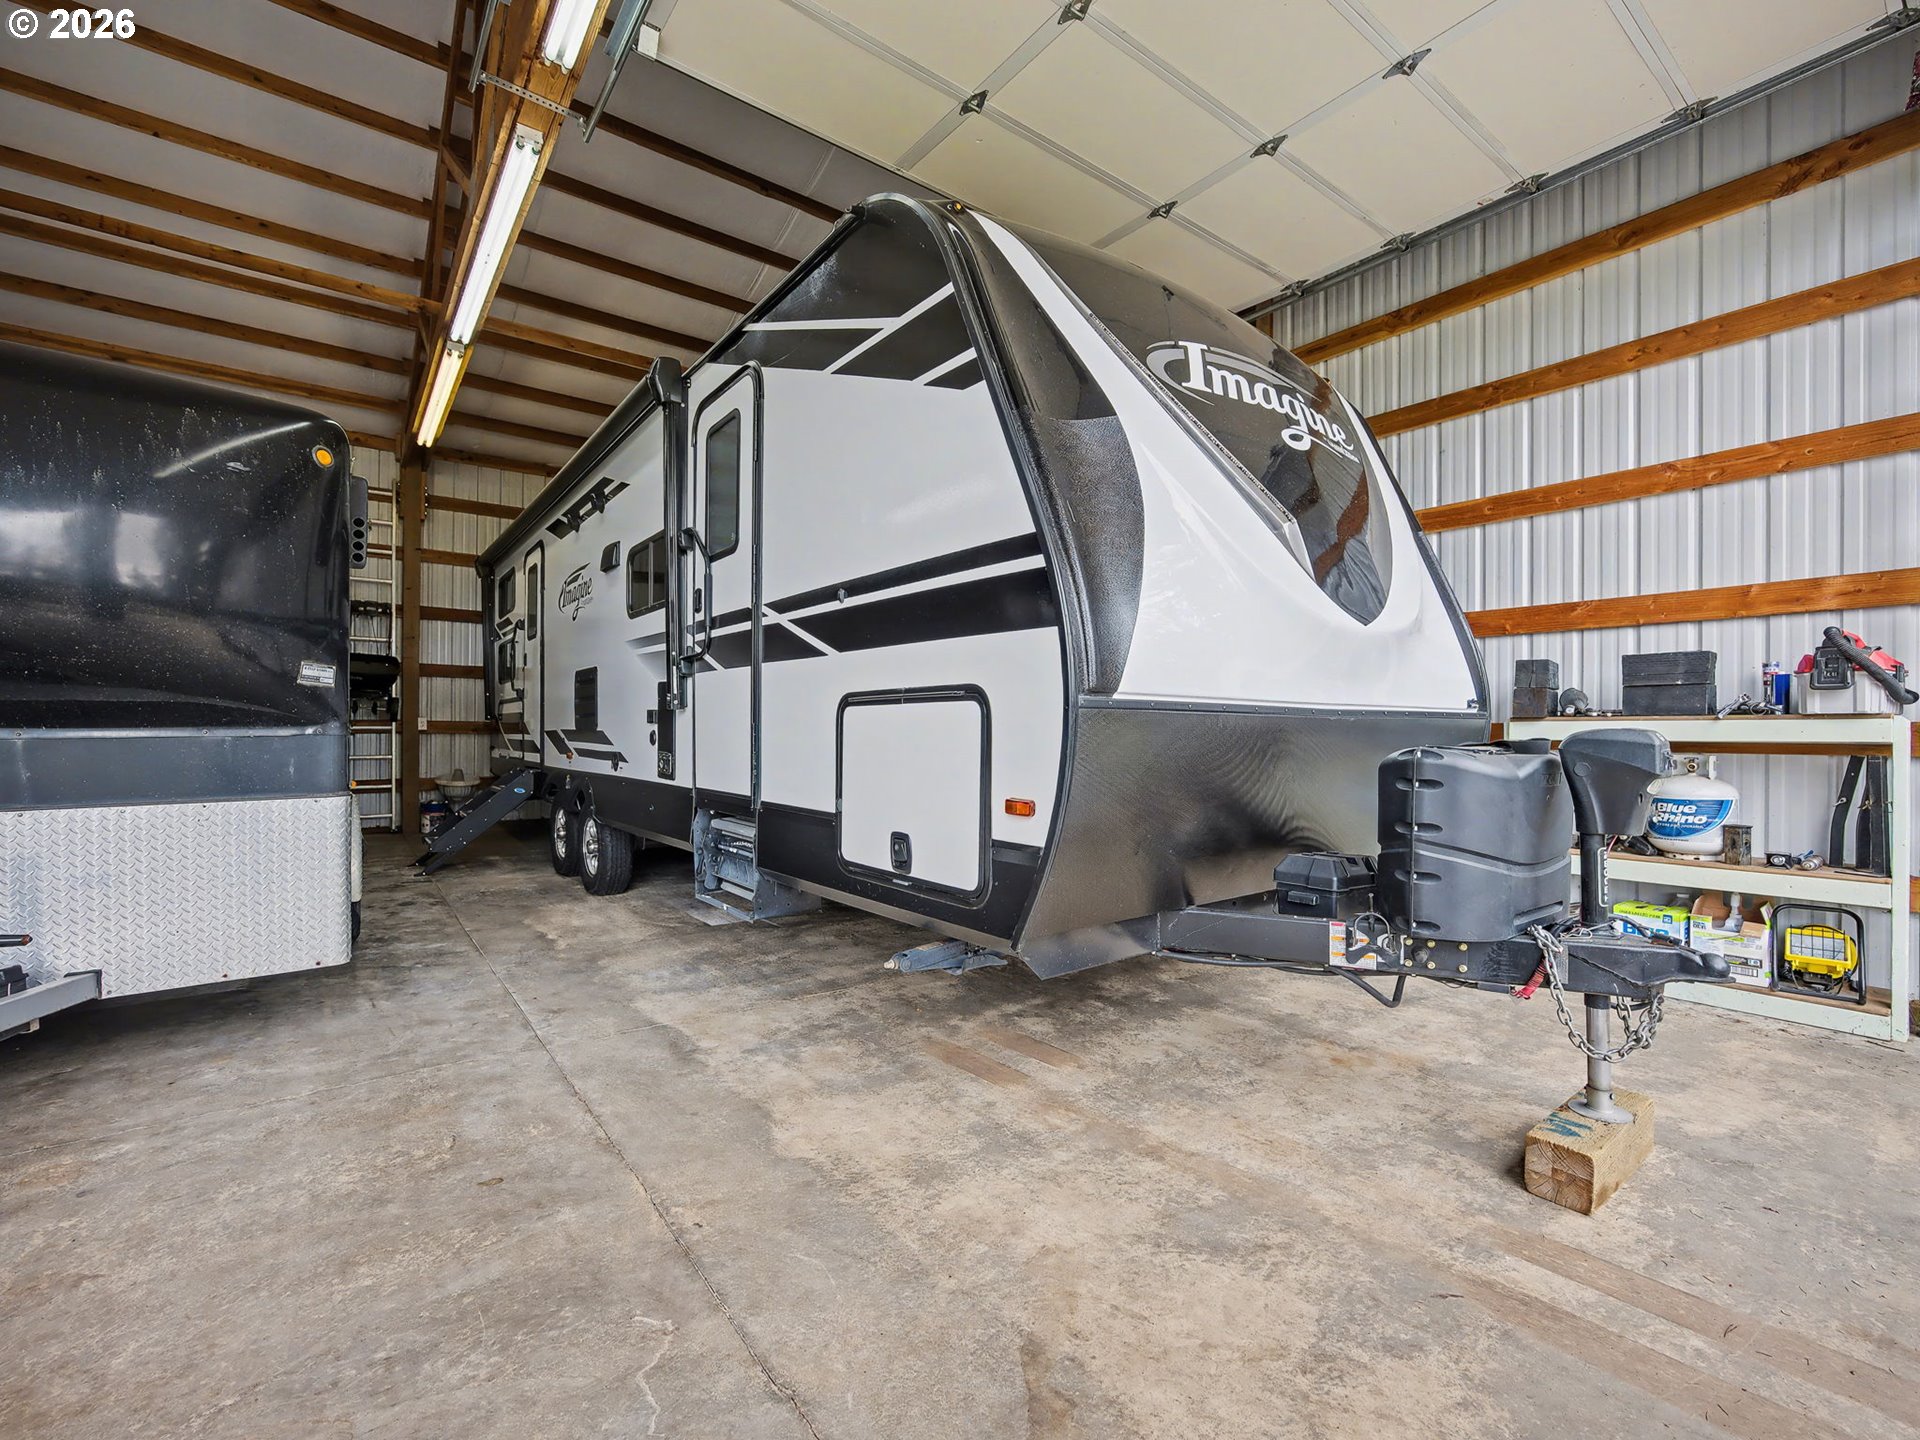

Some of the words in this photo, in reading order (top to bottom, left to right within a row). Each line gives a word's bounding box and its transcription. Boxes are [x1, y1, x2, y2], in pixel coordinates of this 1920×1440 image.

[1177, 340, 1355, 456] Imagine
[560, 573, 594, 622] Imagine
[1653, 812, 1708, 825] Rhino
[1657, 802, 1697, 813] Blue
